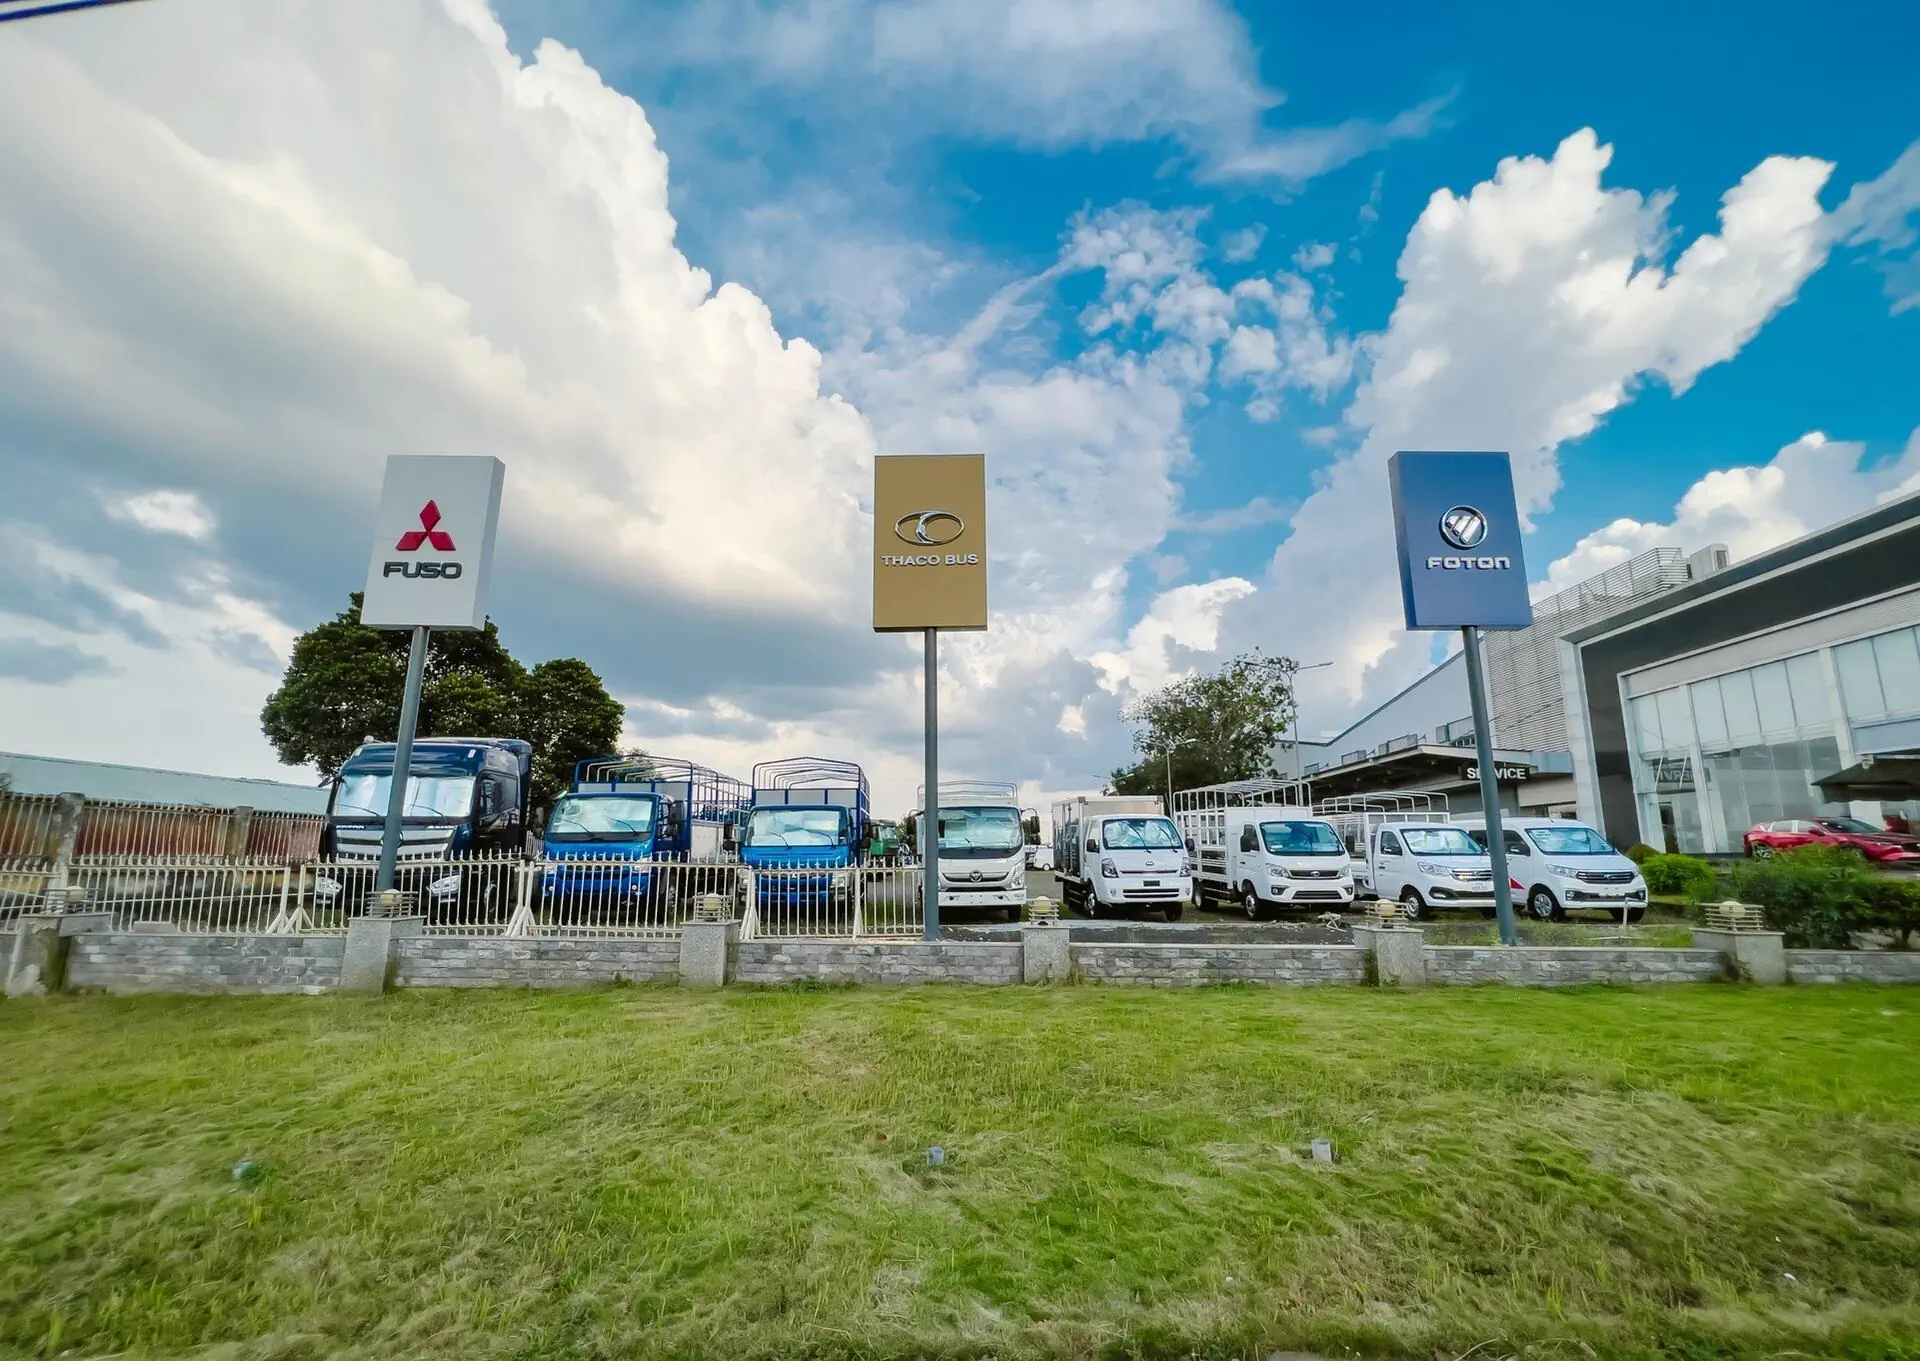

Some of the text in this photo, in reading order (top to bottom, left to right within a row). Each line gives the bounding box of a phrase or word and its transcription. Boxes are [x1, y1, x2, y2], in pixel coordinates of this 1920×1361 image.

[881, 553, 979, 567] THACO BUS
[1425, 556, 1511, 570] FOTON
[383, 561, 463, 579] FUSO
